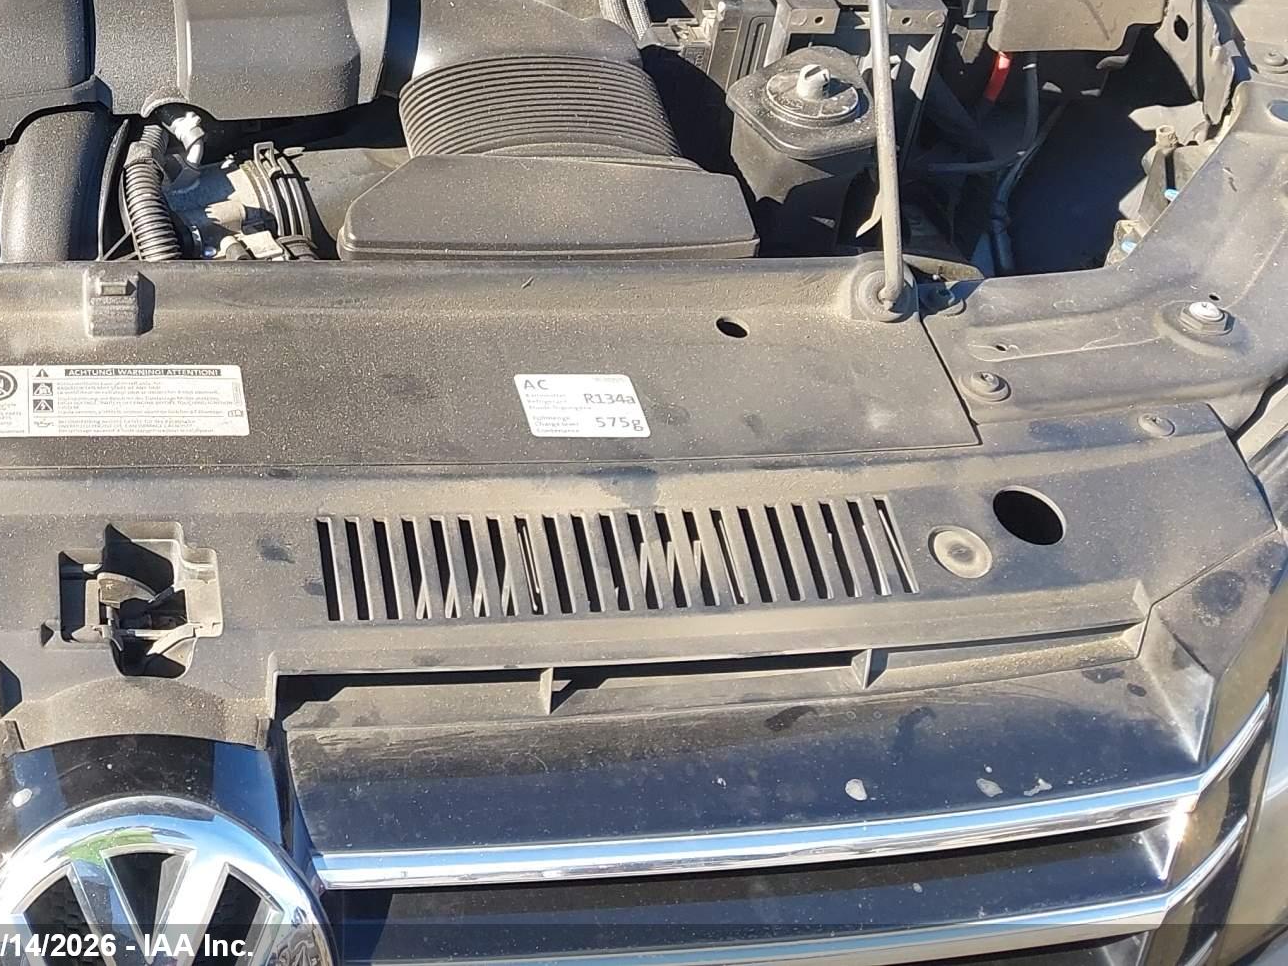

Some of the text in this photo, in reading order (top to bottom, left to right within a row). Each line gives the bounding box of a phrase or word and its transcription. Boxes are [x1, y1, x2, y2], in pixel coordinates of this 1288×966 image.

[523, 379, 549, 390] AC
[583, 392, 637, 404] R134a
[595, 416, 645, 432] 575g
